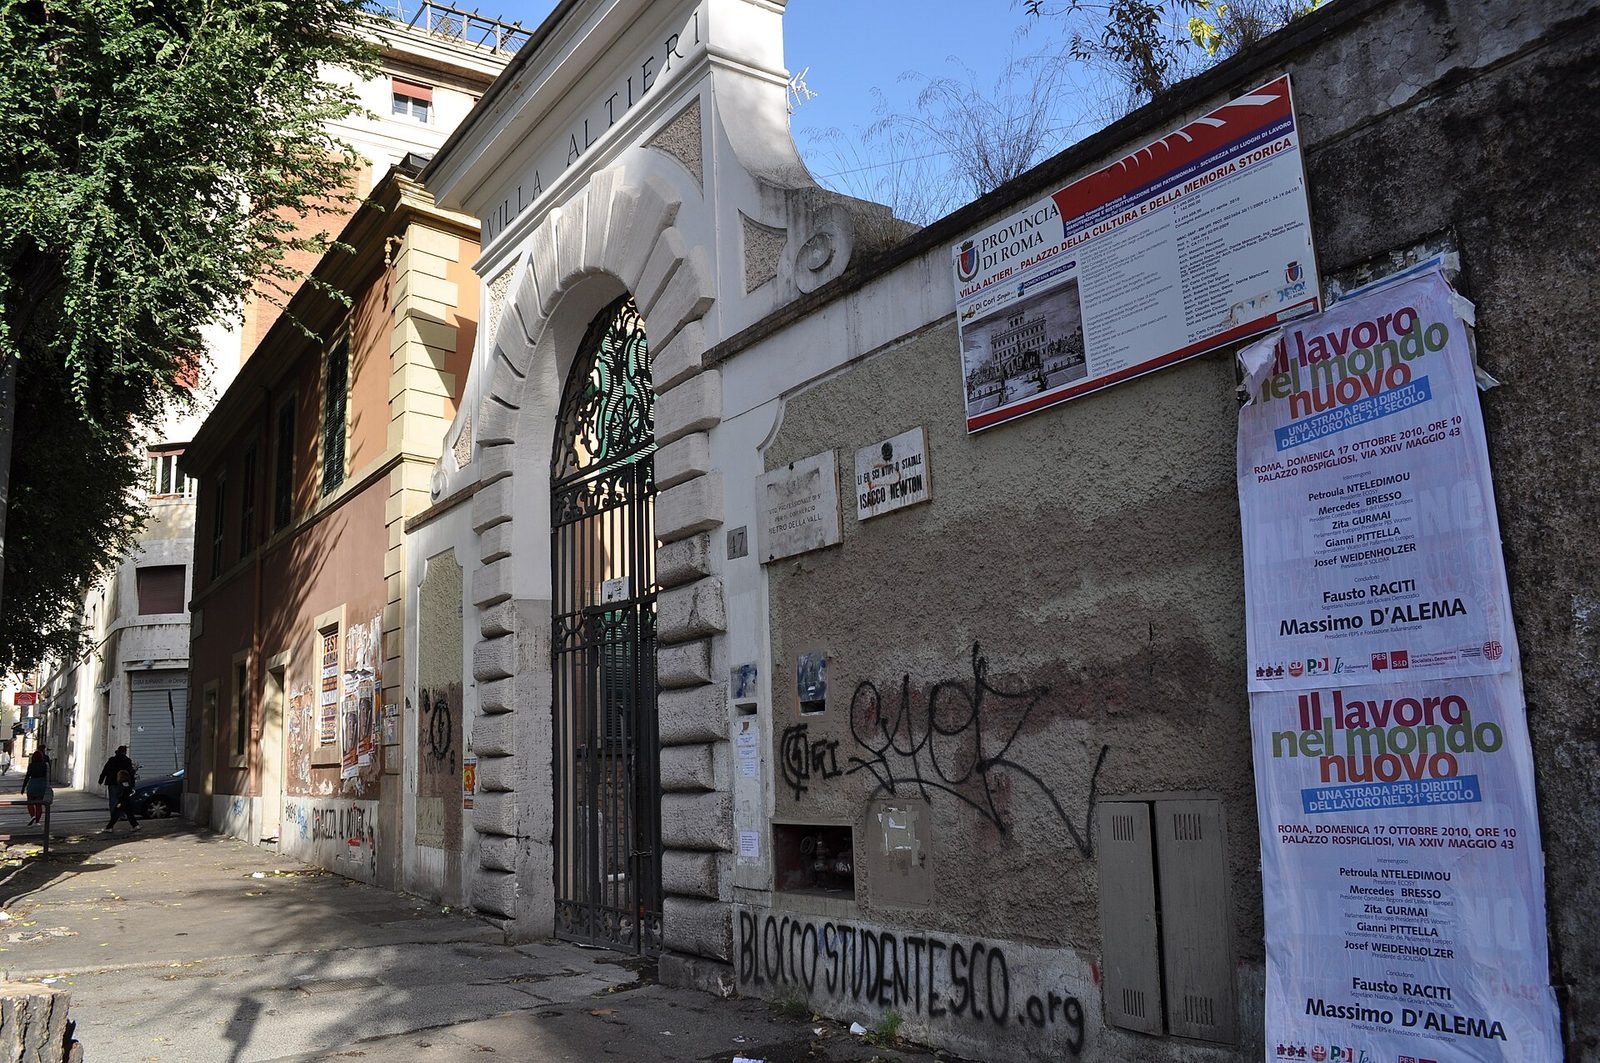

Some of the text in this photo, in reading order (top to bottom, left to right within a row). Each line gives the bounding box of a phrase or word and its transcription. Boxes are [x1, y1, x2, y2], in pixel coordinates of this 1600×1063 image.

[487, 11, 700, 241] VILLA ALTIERI
[1162, 166, 1196, 187] PATRIMONIALI
[1201, 150, 1228, 167] SICUREZZA
[1240, 134, 1260, 148] LUOGHI
[1268, 120, 1292, 136] LAVORO
[960, 284, 981, 298] VILLA
[983, 267, 1013, 288] ALTIERI
[1021, 246, 1058, 270] PALAZZO
[1061, 230, 1090, 250] DELLA
[1092, 210, 1138, 236] CULTURA
[1141, 204, 1147, 214] E
[1150, 189, 1182, 210] DELLA
[1184, 163, 1236, 194] MEMORIA
[1239, 137, 1292, 168] STORICA
[982, 204, 1059, 252] PROVINCIA
[983, 231, 1044, 270] DI ROMA
[1295, 307, 1417, 367] lavoro
[1309, 318, 1449, 389] mondo
[1289, 362, 1411, 419] nuovo
[1282, 437, 1301, 448] DEL
[1302, 422, 1342, 440] LAVORO
[1345, 414, 1365, 426] NEL
[1385, 391, 1425, 414] SECOLO
[1289, 424, 1310, 436] UNA
[1311, 409, 1350, 428] STRADA
[1353, 402, 1372, 414] PER
[1380, 384, 1416, 406] DIRITTI
[1254, 416, 1461, 474] ROMA, DOMENICA 17 OTTOBRE 2010, ORE 10
[1258, 427, 1460, 483] PALAZZO ROSPIGLIOSI, VIA XXIV MAGGIO 43
[860, 474, 922, 510] ISACCO NEWTON
[1309, 472, 1410, 501] Petroula NTELEDIMOU
[1319, 491, 1402, 515] Mercedes BRESSO
[789, 520, 805, 529] DELLA
[1332, 511, 1390, 529] Zita GURMAI
[731, 532, 745, 554] 47
[1325, 527, 1400, 547] Gianni PITTELLA
[1314, 543, 1416, 567] Josef WEIDENHOLZER
[1323, 579, 1416, 603] Fausto RACITI
[1280, 598, 1467, 636] Massimo D'ALEMA
[1372, 653, 1386, 661] PES
[1298, 690, 1468, 730] Il lavoro
[1272, 710, 1503, 758] nel mondo
[1320, 752, 1458, 783] nuovo
[1310, 800, 1332, 811] DEL
[1334, 796, 1381, 810] LAVORO
[1383, 795, 1404, 806] NEL
[1428, 789, 1474, 804] SECOLO
[1316, 789, 1342, 801] UNA
[1345, 785, 1390, 799] STRADA
[1392, 783, 1413, 794] PER
[1422, 779, 1463, 792] DIRITTI
[1278, 825, 1516, 838] ROMA, DOMENICA 17 OTTOBRE 2010, ORE 10
[1282, 835, 1514, 850] PALAZZO ROSPIGLIOSI, VIA XXIV MAGGIO 43
[1340, 867, 1451, 881] Petroula NTELEDIMOU
[1350, 886, 1441, 899] Mercedes BRESSO
[1364, 904, 1428, 917] Zita GURMAI
[1357, 922, 1438, 937] Gianni PITTELLA
[740, 910, 819, 994] BLOCCO
[1345, 941, 1454, 958] Josef WEIDENHOLZER
[1352, 977, 1451, 1000] Fausto RACITI
[1306, 998, 1507, 1041] Massimo D'ALEMA
